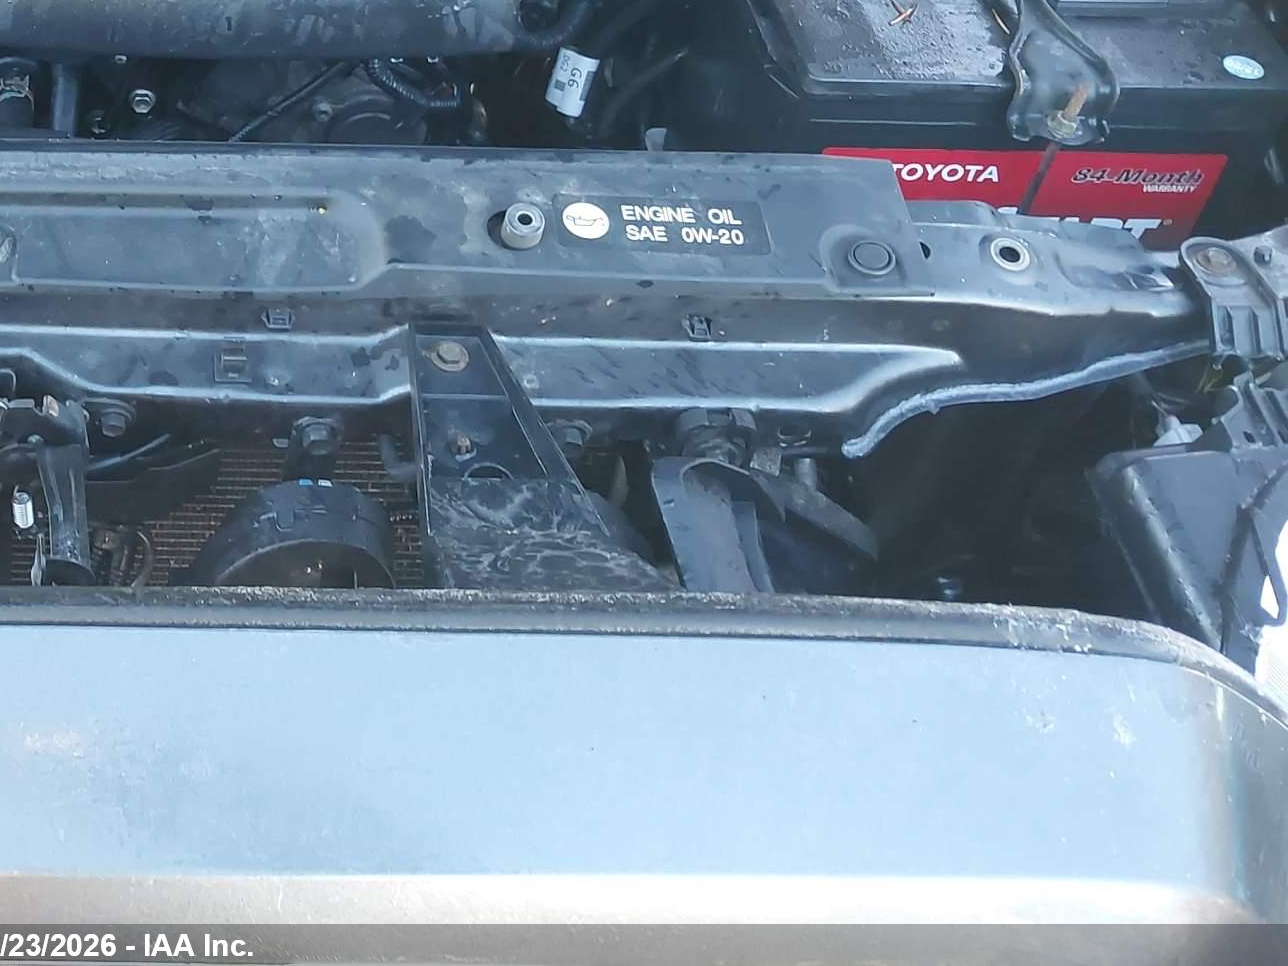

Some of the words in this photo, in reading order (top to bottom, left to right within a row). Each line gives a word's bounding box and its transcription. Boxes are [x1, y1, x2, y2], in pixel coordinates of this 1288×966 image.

[567, 67, 583, 90] G6
[621, 205, 696, 223] ENGINE
[708, 208, 742, 225] OIL
[626, 225, 668, 242] SAE
[681, 227, 744, 245] 0W-20
